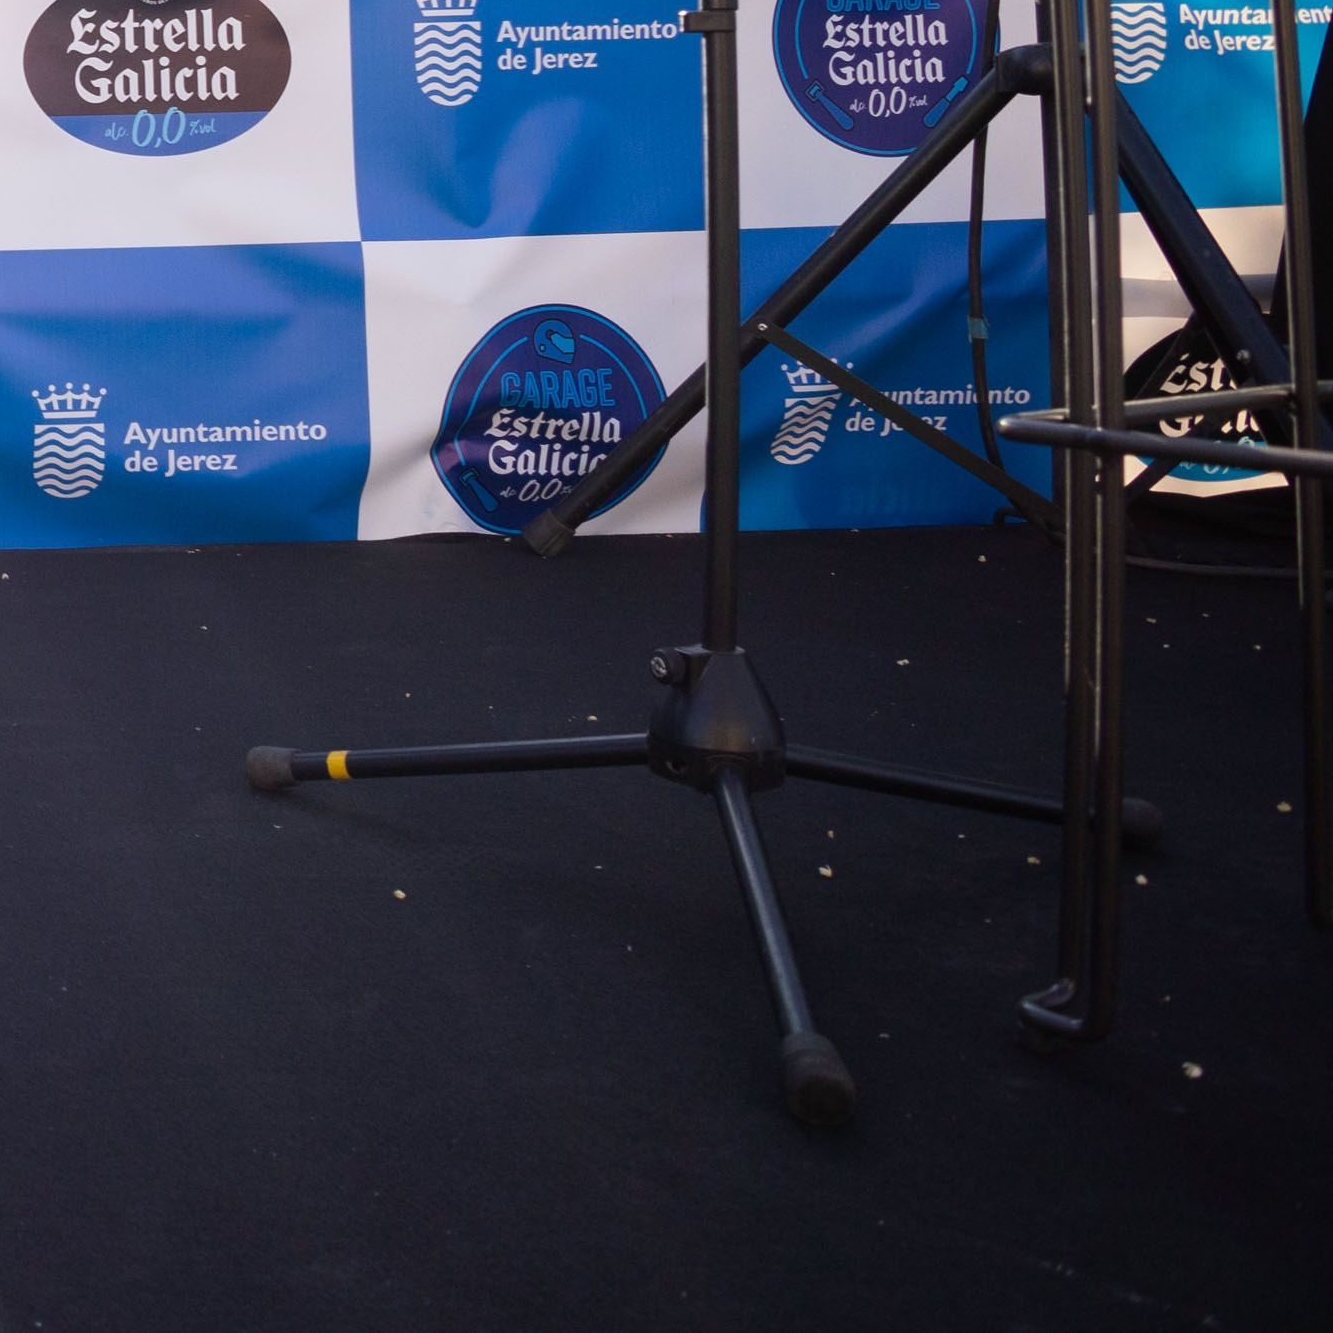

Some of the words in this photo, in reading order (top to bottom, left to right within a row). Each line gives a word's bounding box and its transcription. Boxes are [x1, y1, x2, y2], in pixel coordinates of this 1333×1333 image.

[66, 8, 247, 55] Estrella
[496, 18, 678, 48] Ayuntamiento
[822, 14, 949, 49] Estrella
[1185, 29, 1212, 50] de
[1214, 29, 1276, 56] Jerez
[497, 48, 527, 70] de
[532, 47, 597, 75] Jerez
[828, 50, 946, 86] Galicia
[74, 55, 240, 104] Galicia
[868, 86, 907, 118] 0,0
[132, 106, 186, 148] 0,0
[499, 368, 616, 409] GARAGE
[123, 419, 327, 450] Ayuntamiento
[484, 409, 621, 444] Estrella
[845, 412, 875, 432] de
[125, 450, 158, 472] de
[164, 449, 238, 477] Jerez
[518, 478, 562, 502] 0,0
